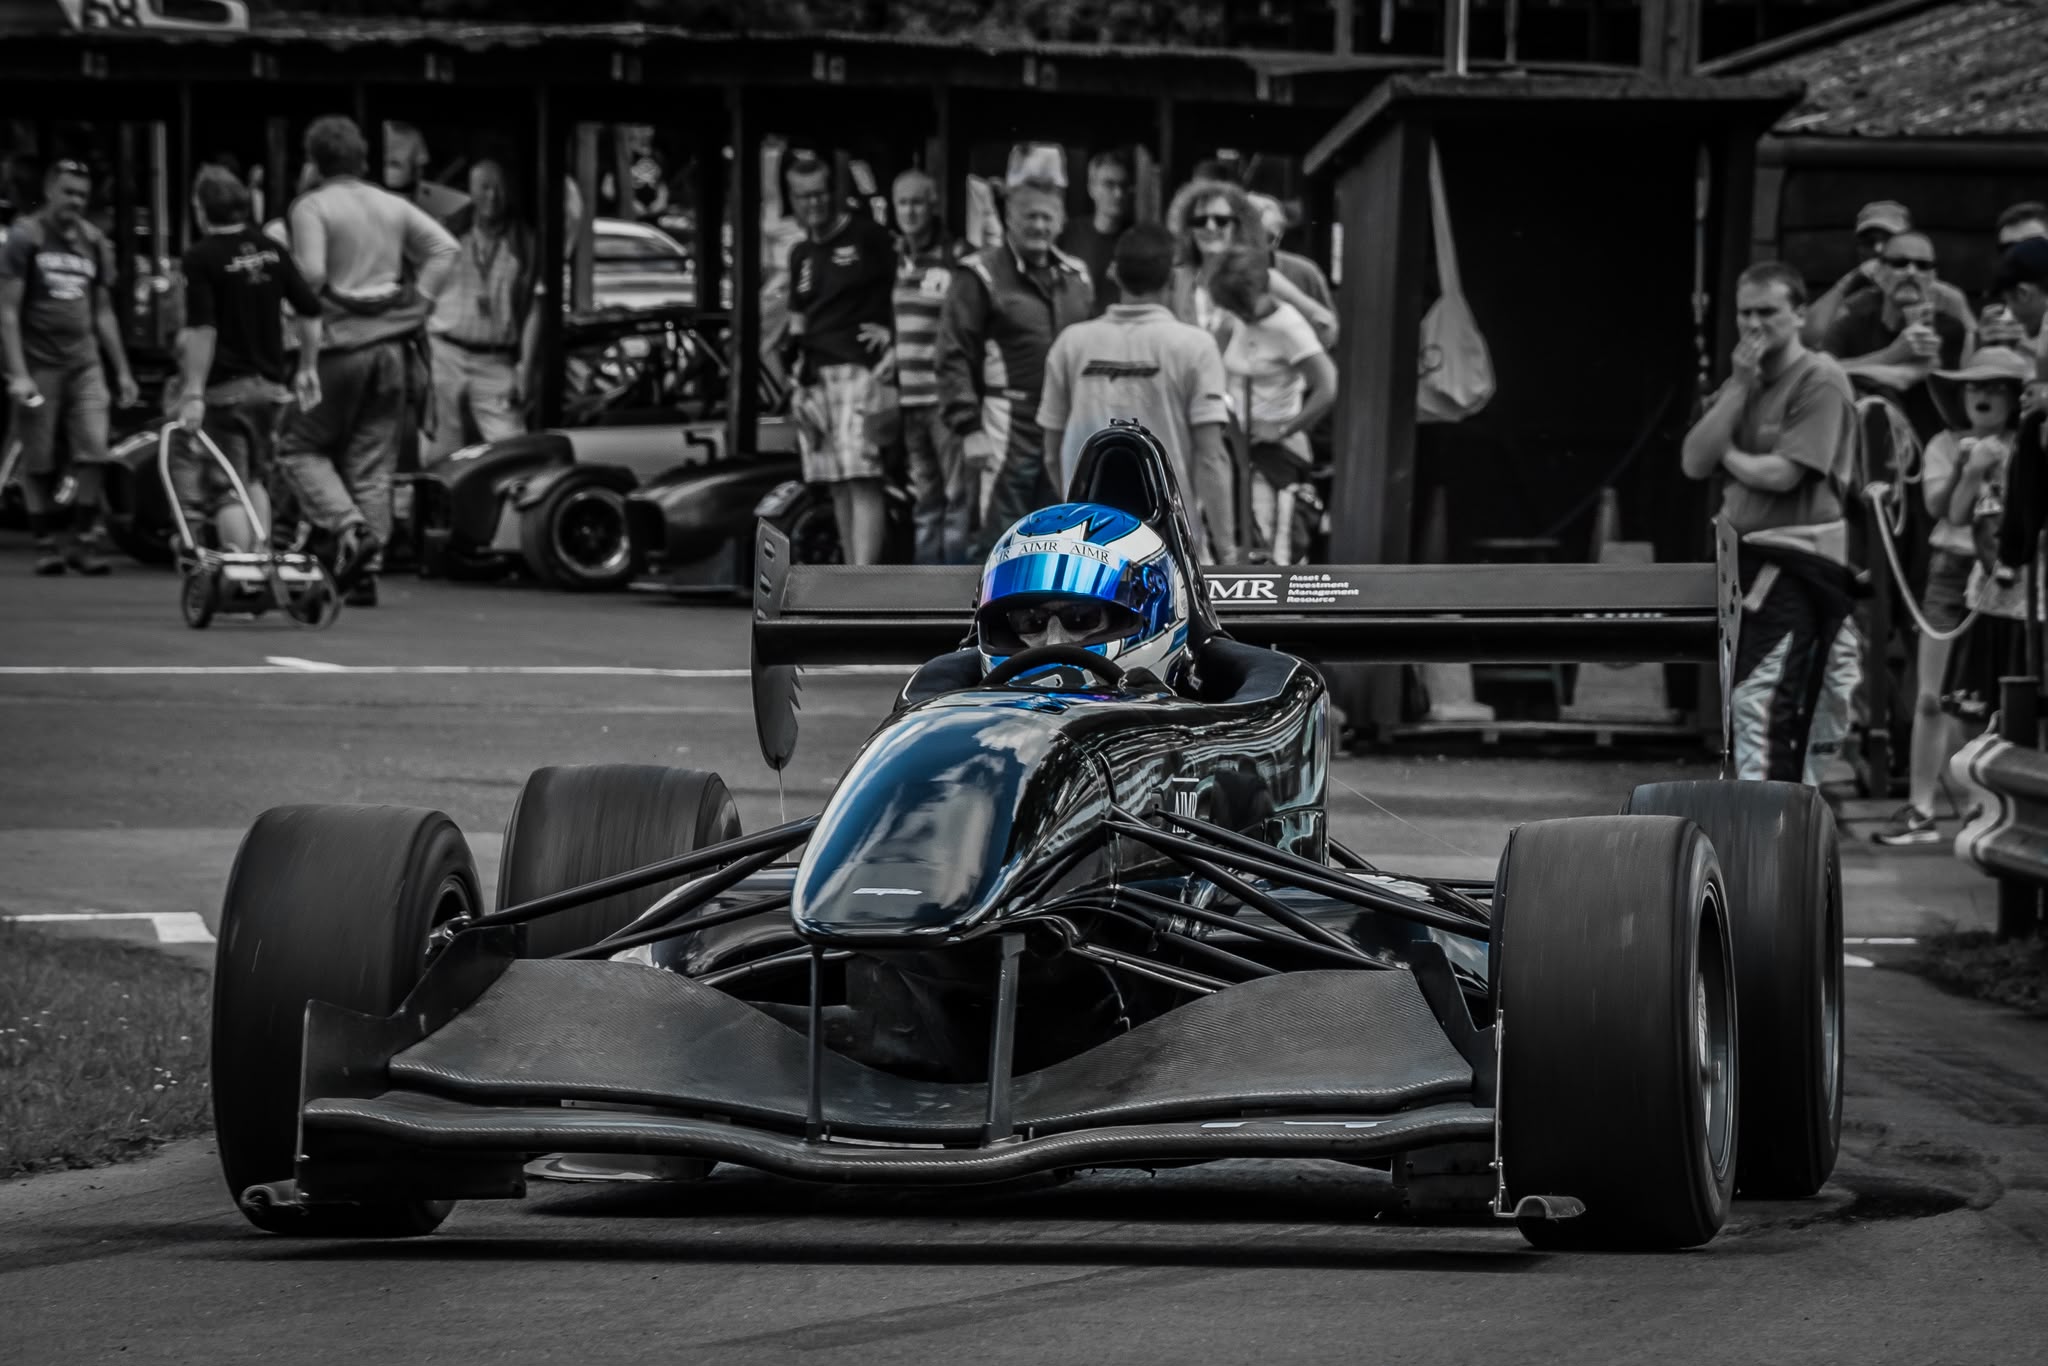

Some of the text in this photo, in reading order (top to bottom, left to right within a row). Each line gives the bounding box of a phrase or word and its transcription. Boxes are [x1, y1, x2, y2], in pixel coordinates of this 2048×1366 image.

[1020, 541, 1058, 554] AIMR
[1070, 544, 1110, 563] AIMR
[1289, 574, 1320, 582] Asset
[1203, 579, 1279, 599] MR
[1289, 581, 1350, 589] Investment
[1287, 588, 1360, 597] Management
